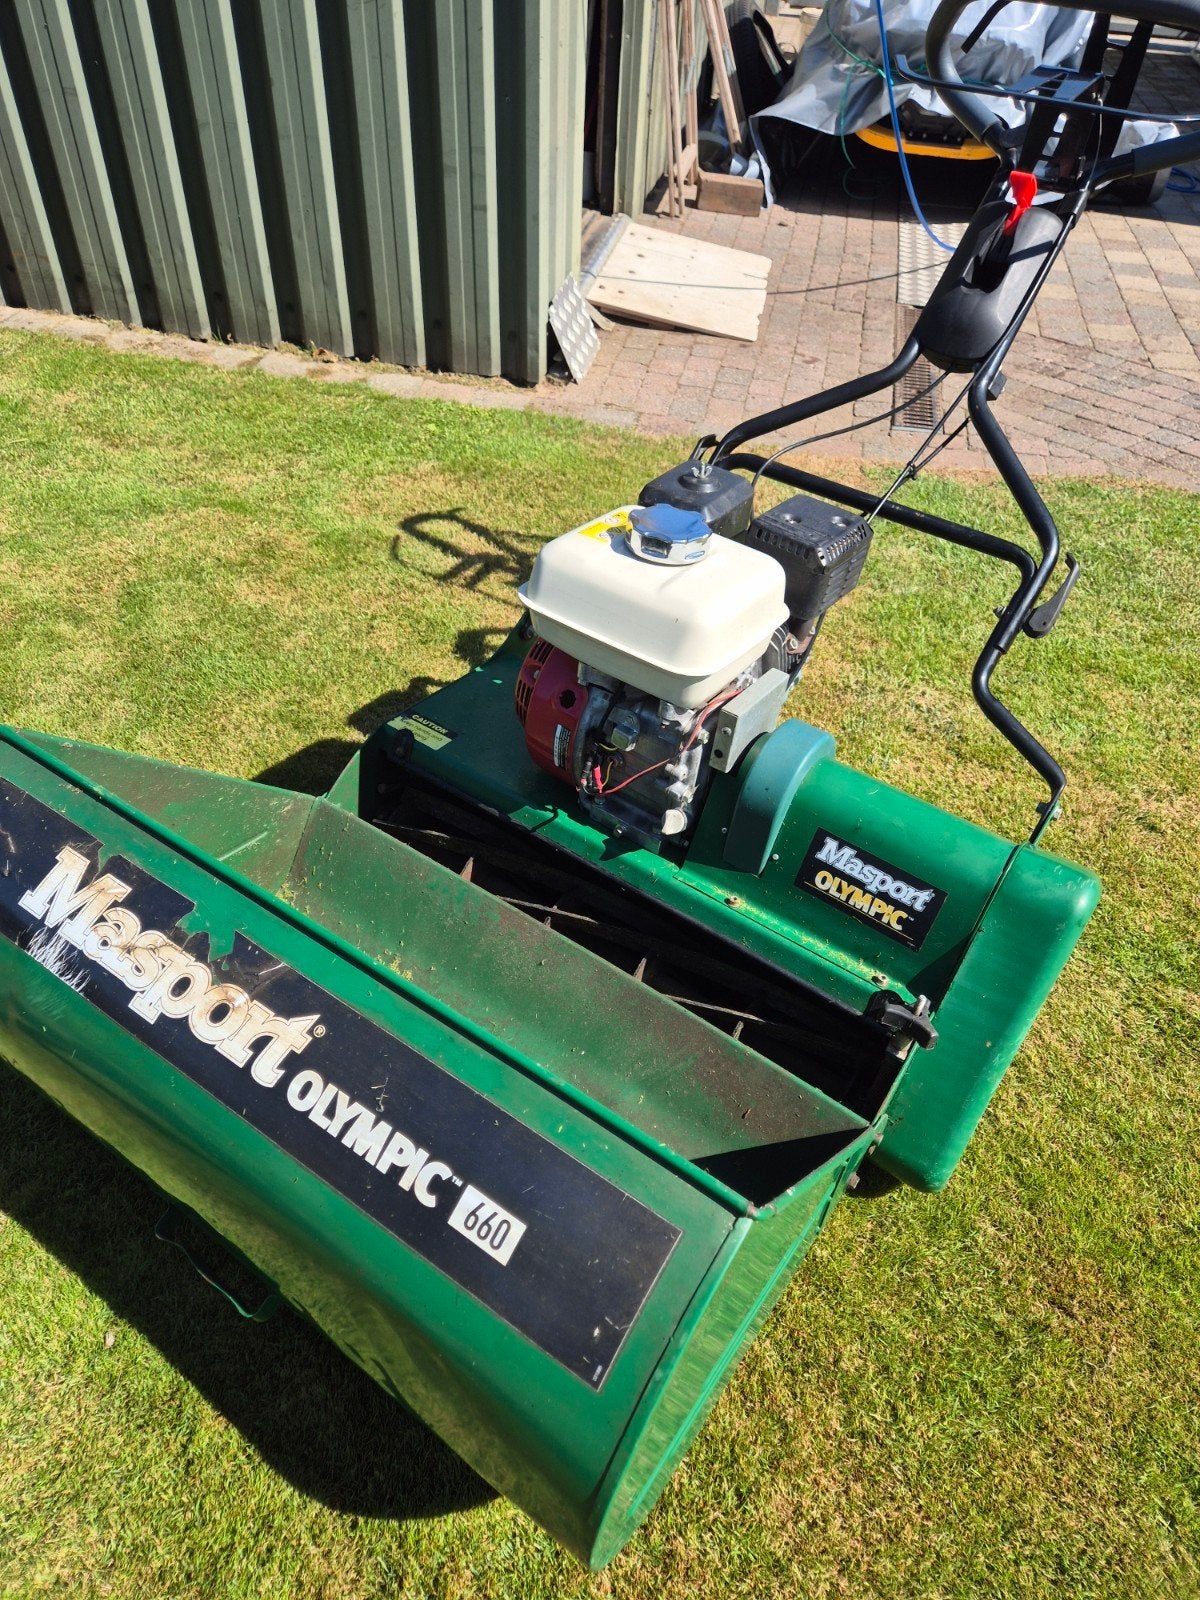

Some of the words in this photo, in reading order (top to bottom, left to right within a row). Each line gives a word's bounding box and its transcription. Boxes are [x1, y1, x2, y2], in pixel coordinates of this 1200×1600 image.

[412, 714, 449, 734] CAUTION
[815, 837, 936, 912] Masport
[815, 870, 909, 931] OLYMPIC
[18, 846, 321, 1088] Masport
[286, 1070, 453, 1208] OLYMPIC
[463, 1202, 512, 1251] 660
